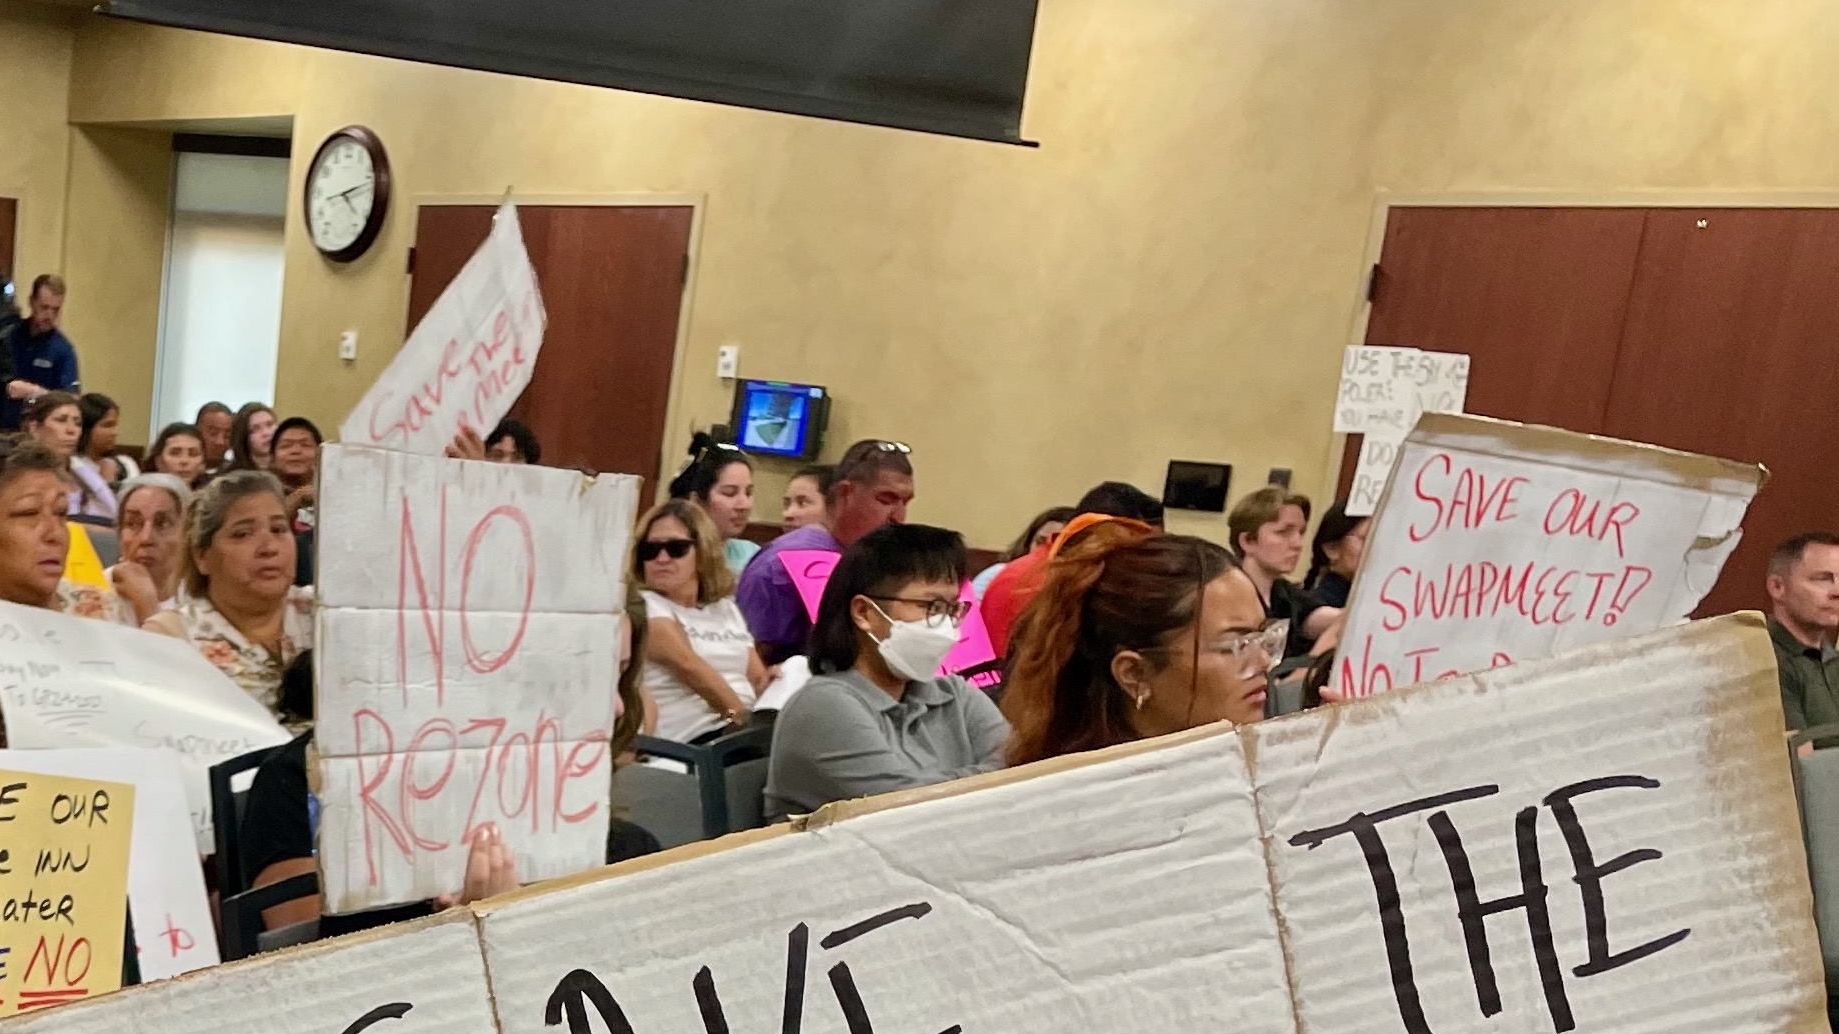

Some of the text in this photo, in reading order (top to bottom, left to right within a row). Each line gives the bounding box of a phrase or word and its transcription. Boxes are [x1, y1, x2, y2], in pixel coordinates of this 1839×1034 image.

[1344, 350, 1380, 377] USE
[1409, 453, 1641, 559] SAVE OUR
[396, 482, 536, 708] NO
[1379, 560, 1654, 632] SWAPMEET!
[51, 789, 111, 828] OUR
[34, 845, 91, 878] INN
[23, 933, 93, 987] NO
